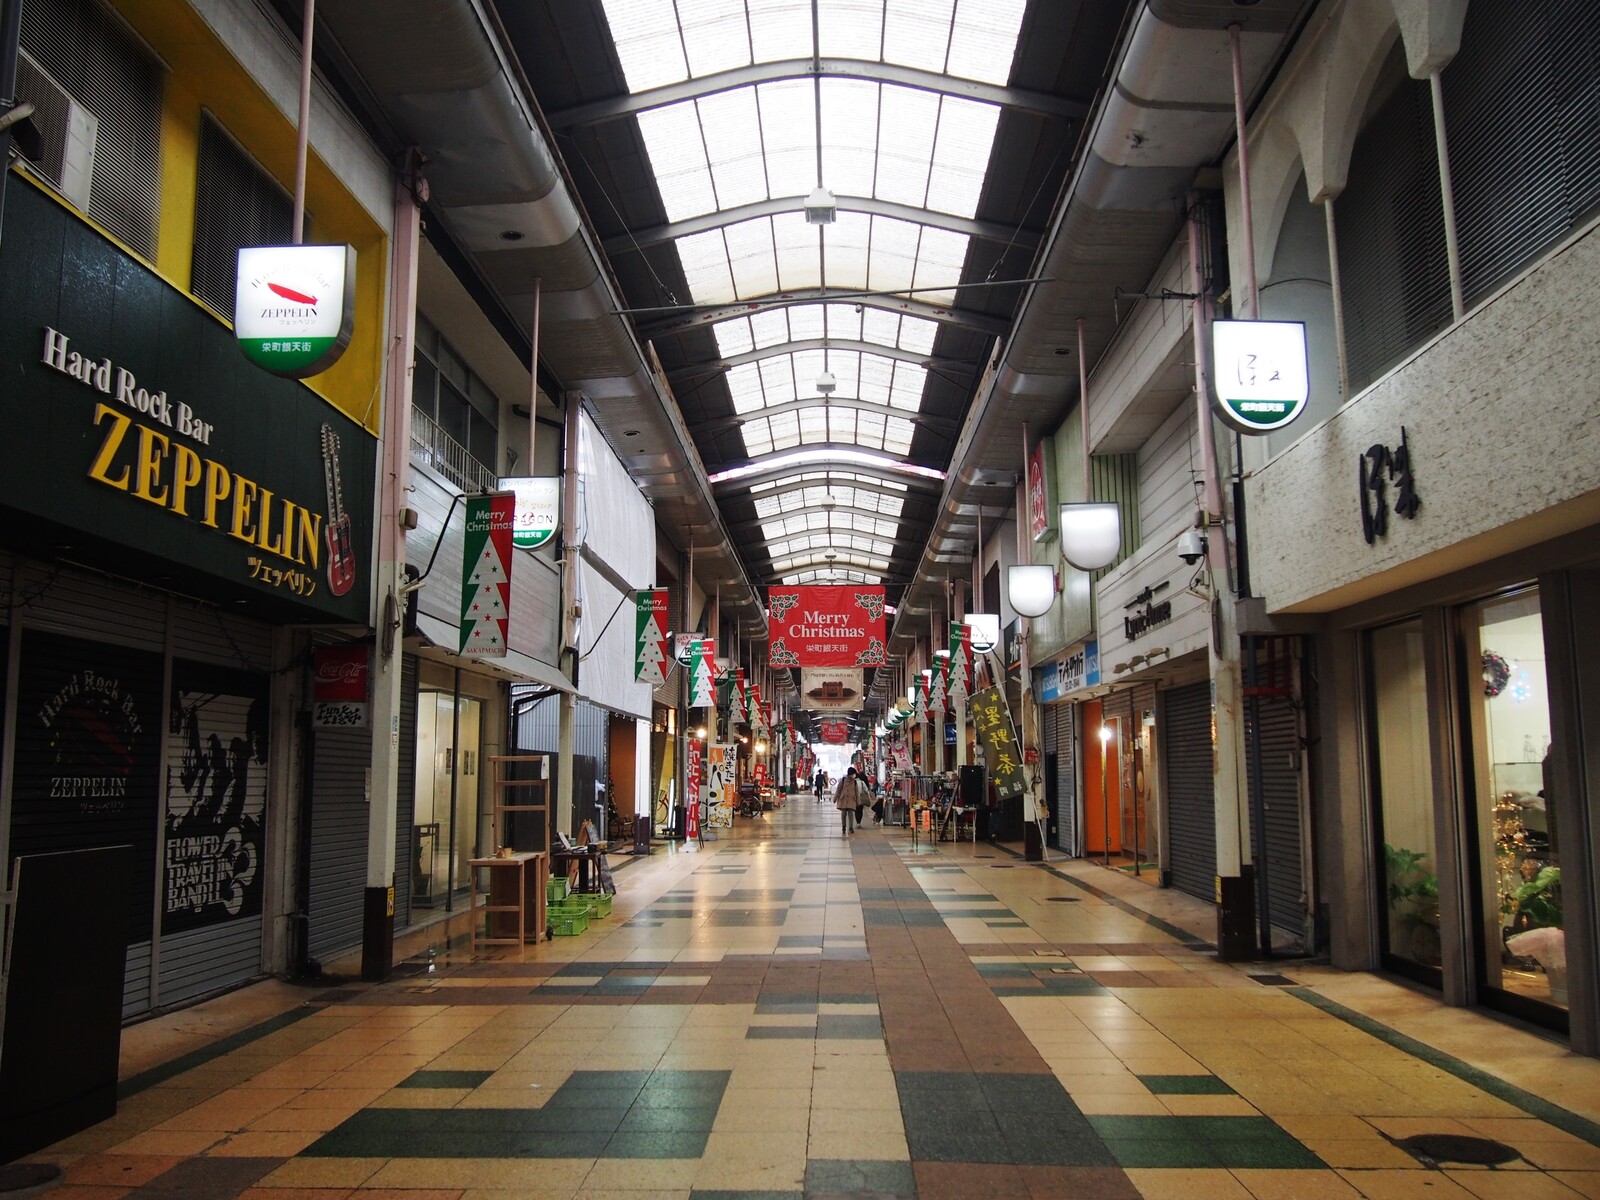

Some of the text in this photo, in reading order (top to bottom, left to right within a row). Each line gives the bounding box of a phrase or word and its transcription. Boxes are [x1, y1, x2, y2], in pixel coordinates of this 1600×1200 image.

[260, 307, 319, 319] ZEPPELIN
[262, 341, 313, 352] 栄町銀天街
[41, 326, 214, 445] Hard Rock Bar
[87, 402, 322, 569] ZEPPELIN
[475, 510, 505, 522] Merry
[466, 520, 513, 532] Christmas
[247, 555, 317, 598] ツェッペリン
[637, 604, 667, 612] Christmas
[643, 598, 662, 606] Merry
[803, 611, 850, 627] Merry
[789, 624, 865, 638] Christmas
[806, 644, 848, 653] 栄町銀天街
[319, 662, 368, 680] Coca-Cola
[84, 670, 119, 700] Rock
[50, 777, 128, 798] ZEPPELIN
